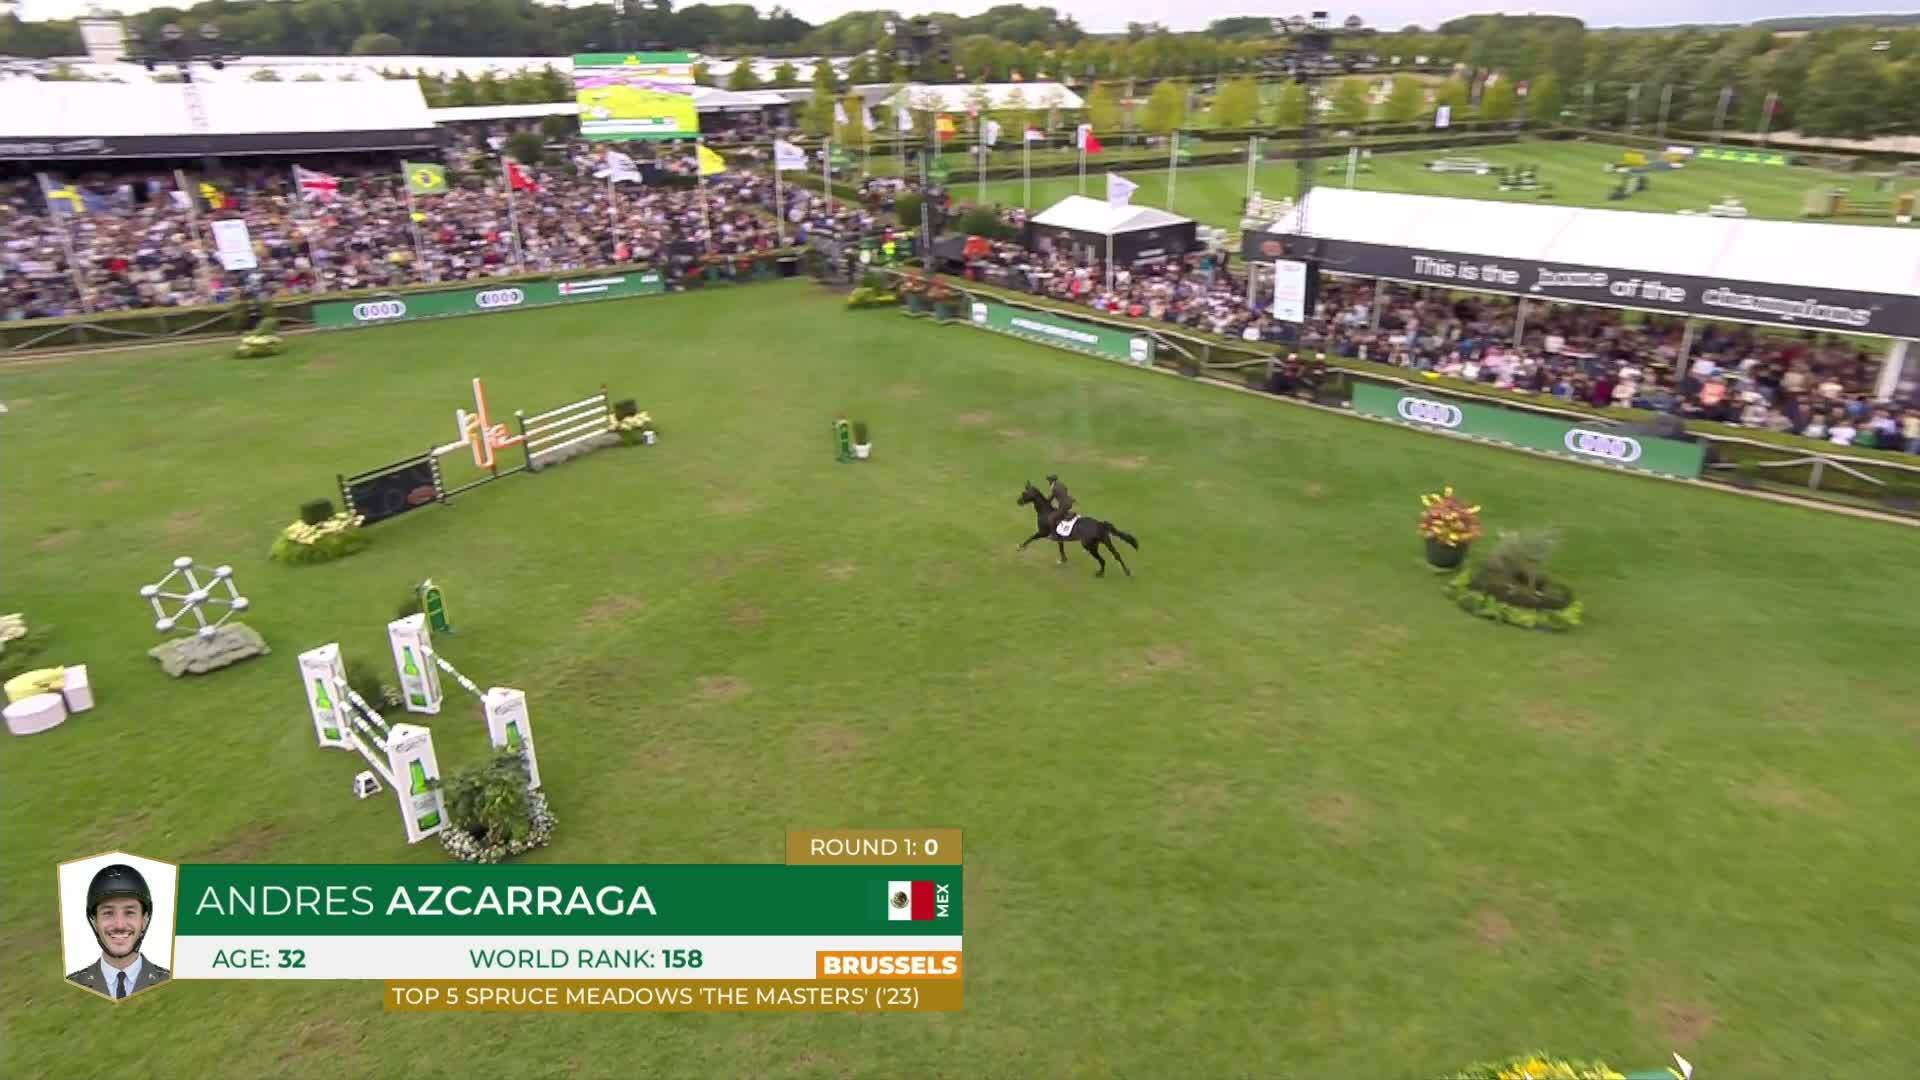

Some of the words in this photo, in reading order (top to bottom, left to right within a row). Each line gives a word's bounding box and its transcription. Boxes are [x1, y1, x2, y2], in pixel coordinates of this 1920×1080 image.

[1411, 255, 1456, 278] This
[1458, 260, 1480, 280] is
[1480, 264, 1520, 285] the
[1641, 281, 1686, 302] the
